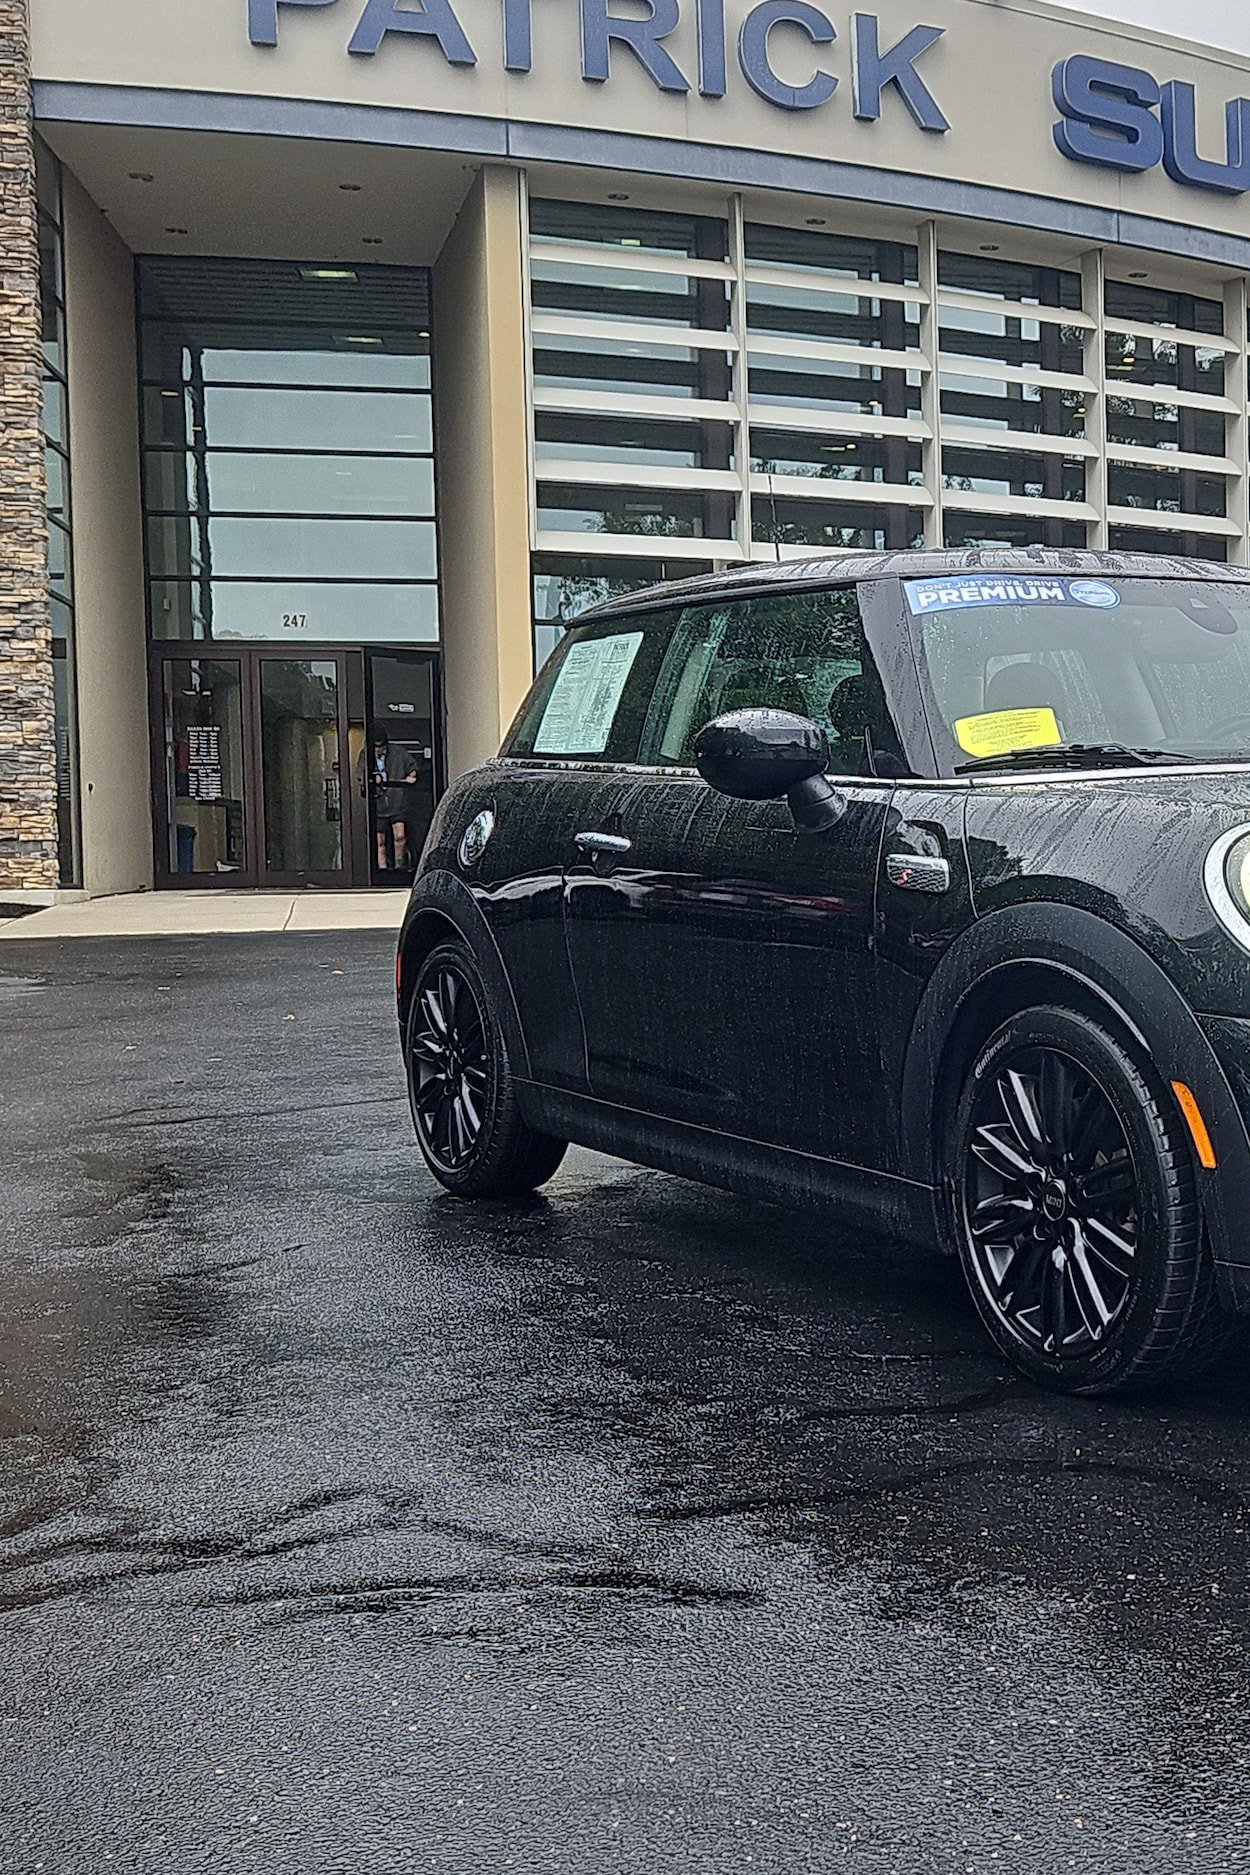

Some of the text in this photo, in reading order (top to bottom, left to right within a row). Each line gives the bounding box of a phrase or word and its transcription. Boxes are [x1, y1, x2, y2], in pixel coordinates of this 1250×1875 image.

[916, 582, 952, 593] DON'T
[956, 580, 982, 588] JUST
[917, 585, 1066, 607] PREMIUM
[282, 614, 307, 628] 247
